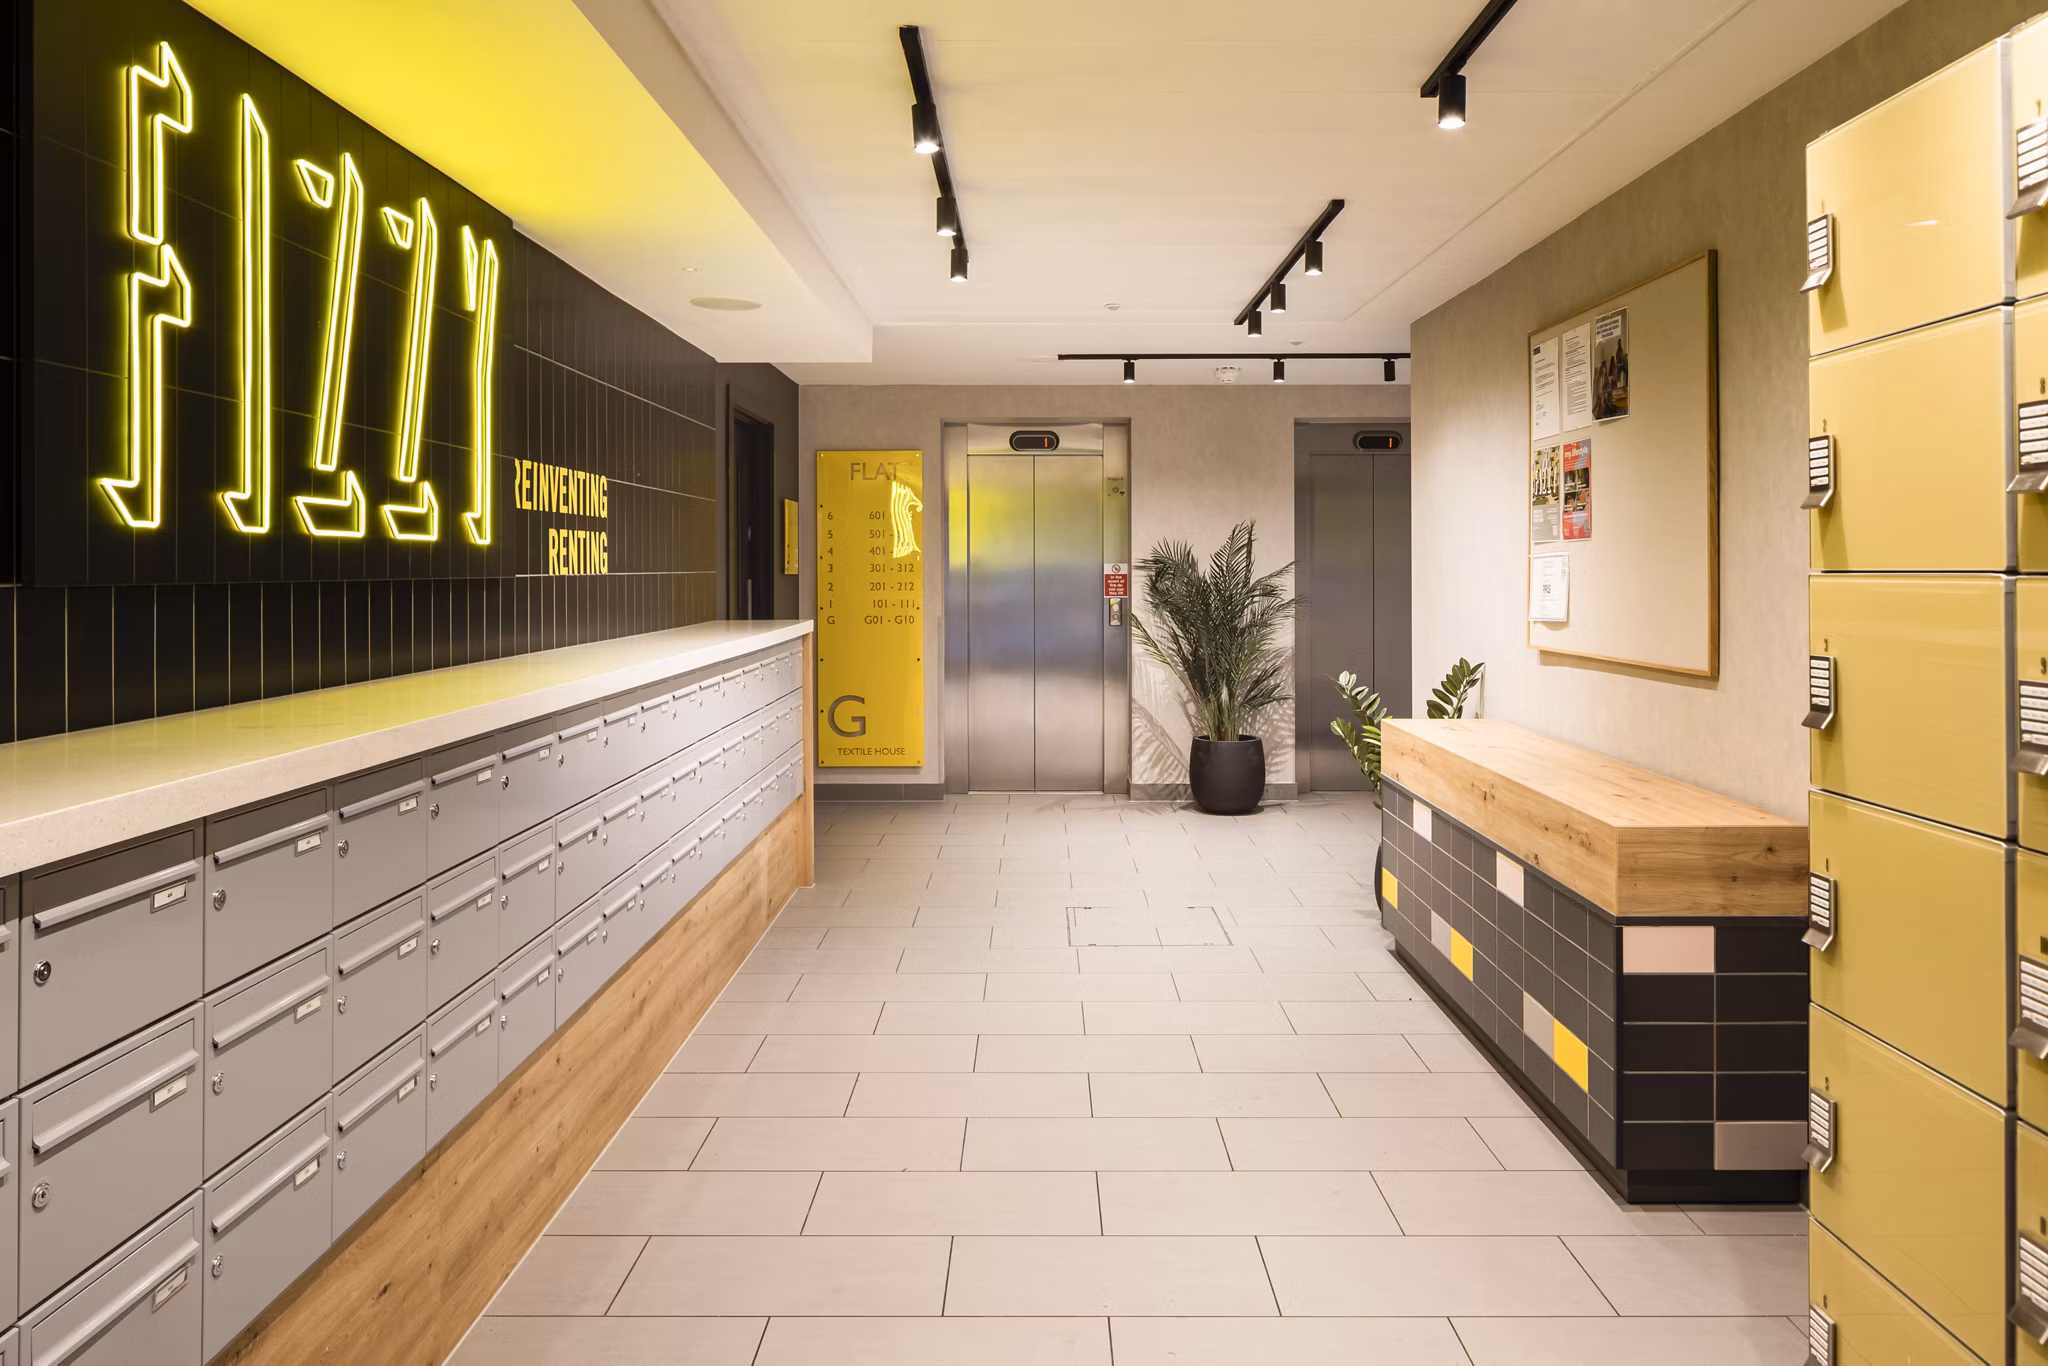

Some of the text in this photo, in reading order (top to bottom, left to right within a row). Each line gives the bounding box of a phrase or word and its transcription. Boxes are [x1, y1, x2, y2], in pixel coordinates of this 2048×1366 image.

[1822, 418, 1827, 432] 2
[514, 458, 608, 519] REINVENTING
[827, 511, 885, 520] 6 601
[827, 530, 833, 539] 5
[869, 529, 885, 539] 501
[548, 528, 608, 576] RENTING
[827, 547, 833, 556] 4
[869, 546, 885, 556] 401
[828, 563, 833, 573] 3
[869, 563, 886, 573] 301
[897, 563, 915, 573] 312
[828, 582, 834, 592] 2
[869, 582, 886, 591] 201
[897, 582, 915, 591] 212
[873, 599, 888, 608] 101
[900, 599, 915, 608] 111
[826, 615, 836, 625] G
[864, 615, 883, 625] G01
[894, 615, 915, 625] G10
[2040, 657, 2047, 675] 9
[827, 694, 867, 738] G
[837, 747, 906, 756] TEXTILE HOUSE
